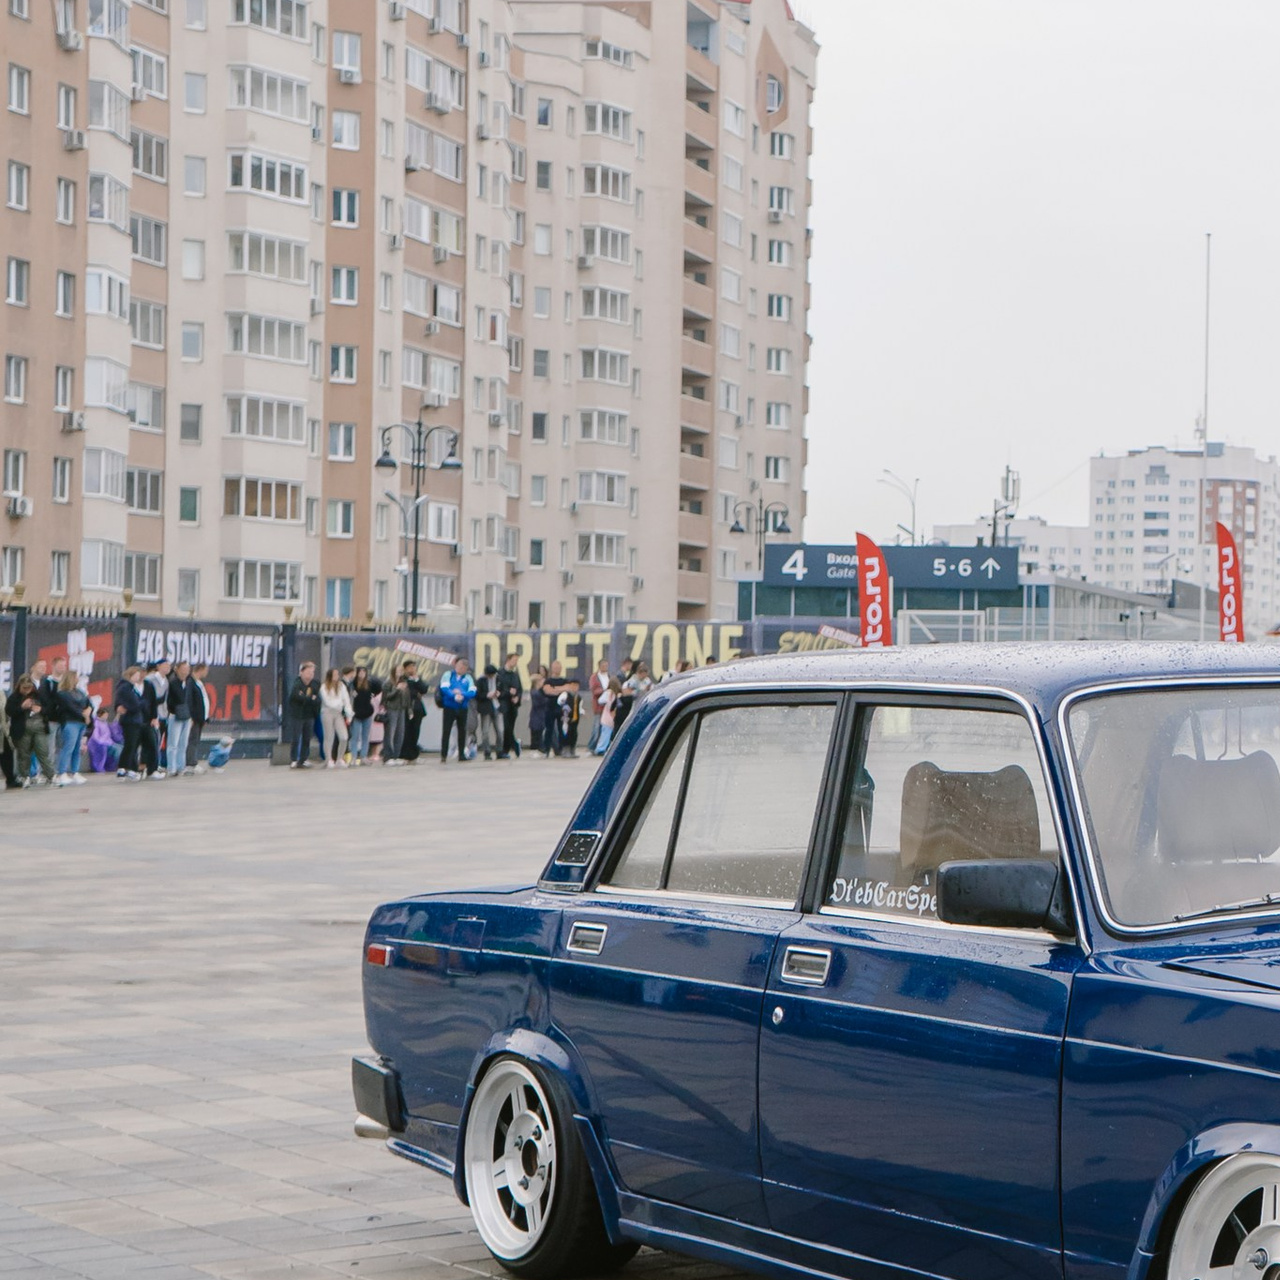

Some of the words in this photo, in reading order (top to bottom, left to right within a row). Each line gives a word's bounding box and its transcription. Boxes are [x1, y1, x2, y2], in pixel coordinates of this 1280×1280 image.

[781, 549, 808, 581] 4
[826, 552, 859, 566] Вход
[826, 566, 856, 579] Gate
[864, 557, 884, 648] to.ru
[136, 629, 164, 664] EKB
[166, 630, 228, 666] STADIUM
[230, 634, 273, 667] MEET
[475, 632, 612, 691] DRIFT
[625, 623, 744, 681] ZONE
[204, 682, 261, 720] o.ru
[829, 877, 938, 916] Ot'ebCarSpe
